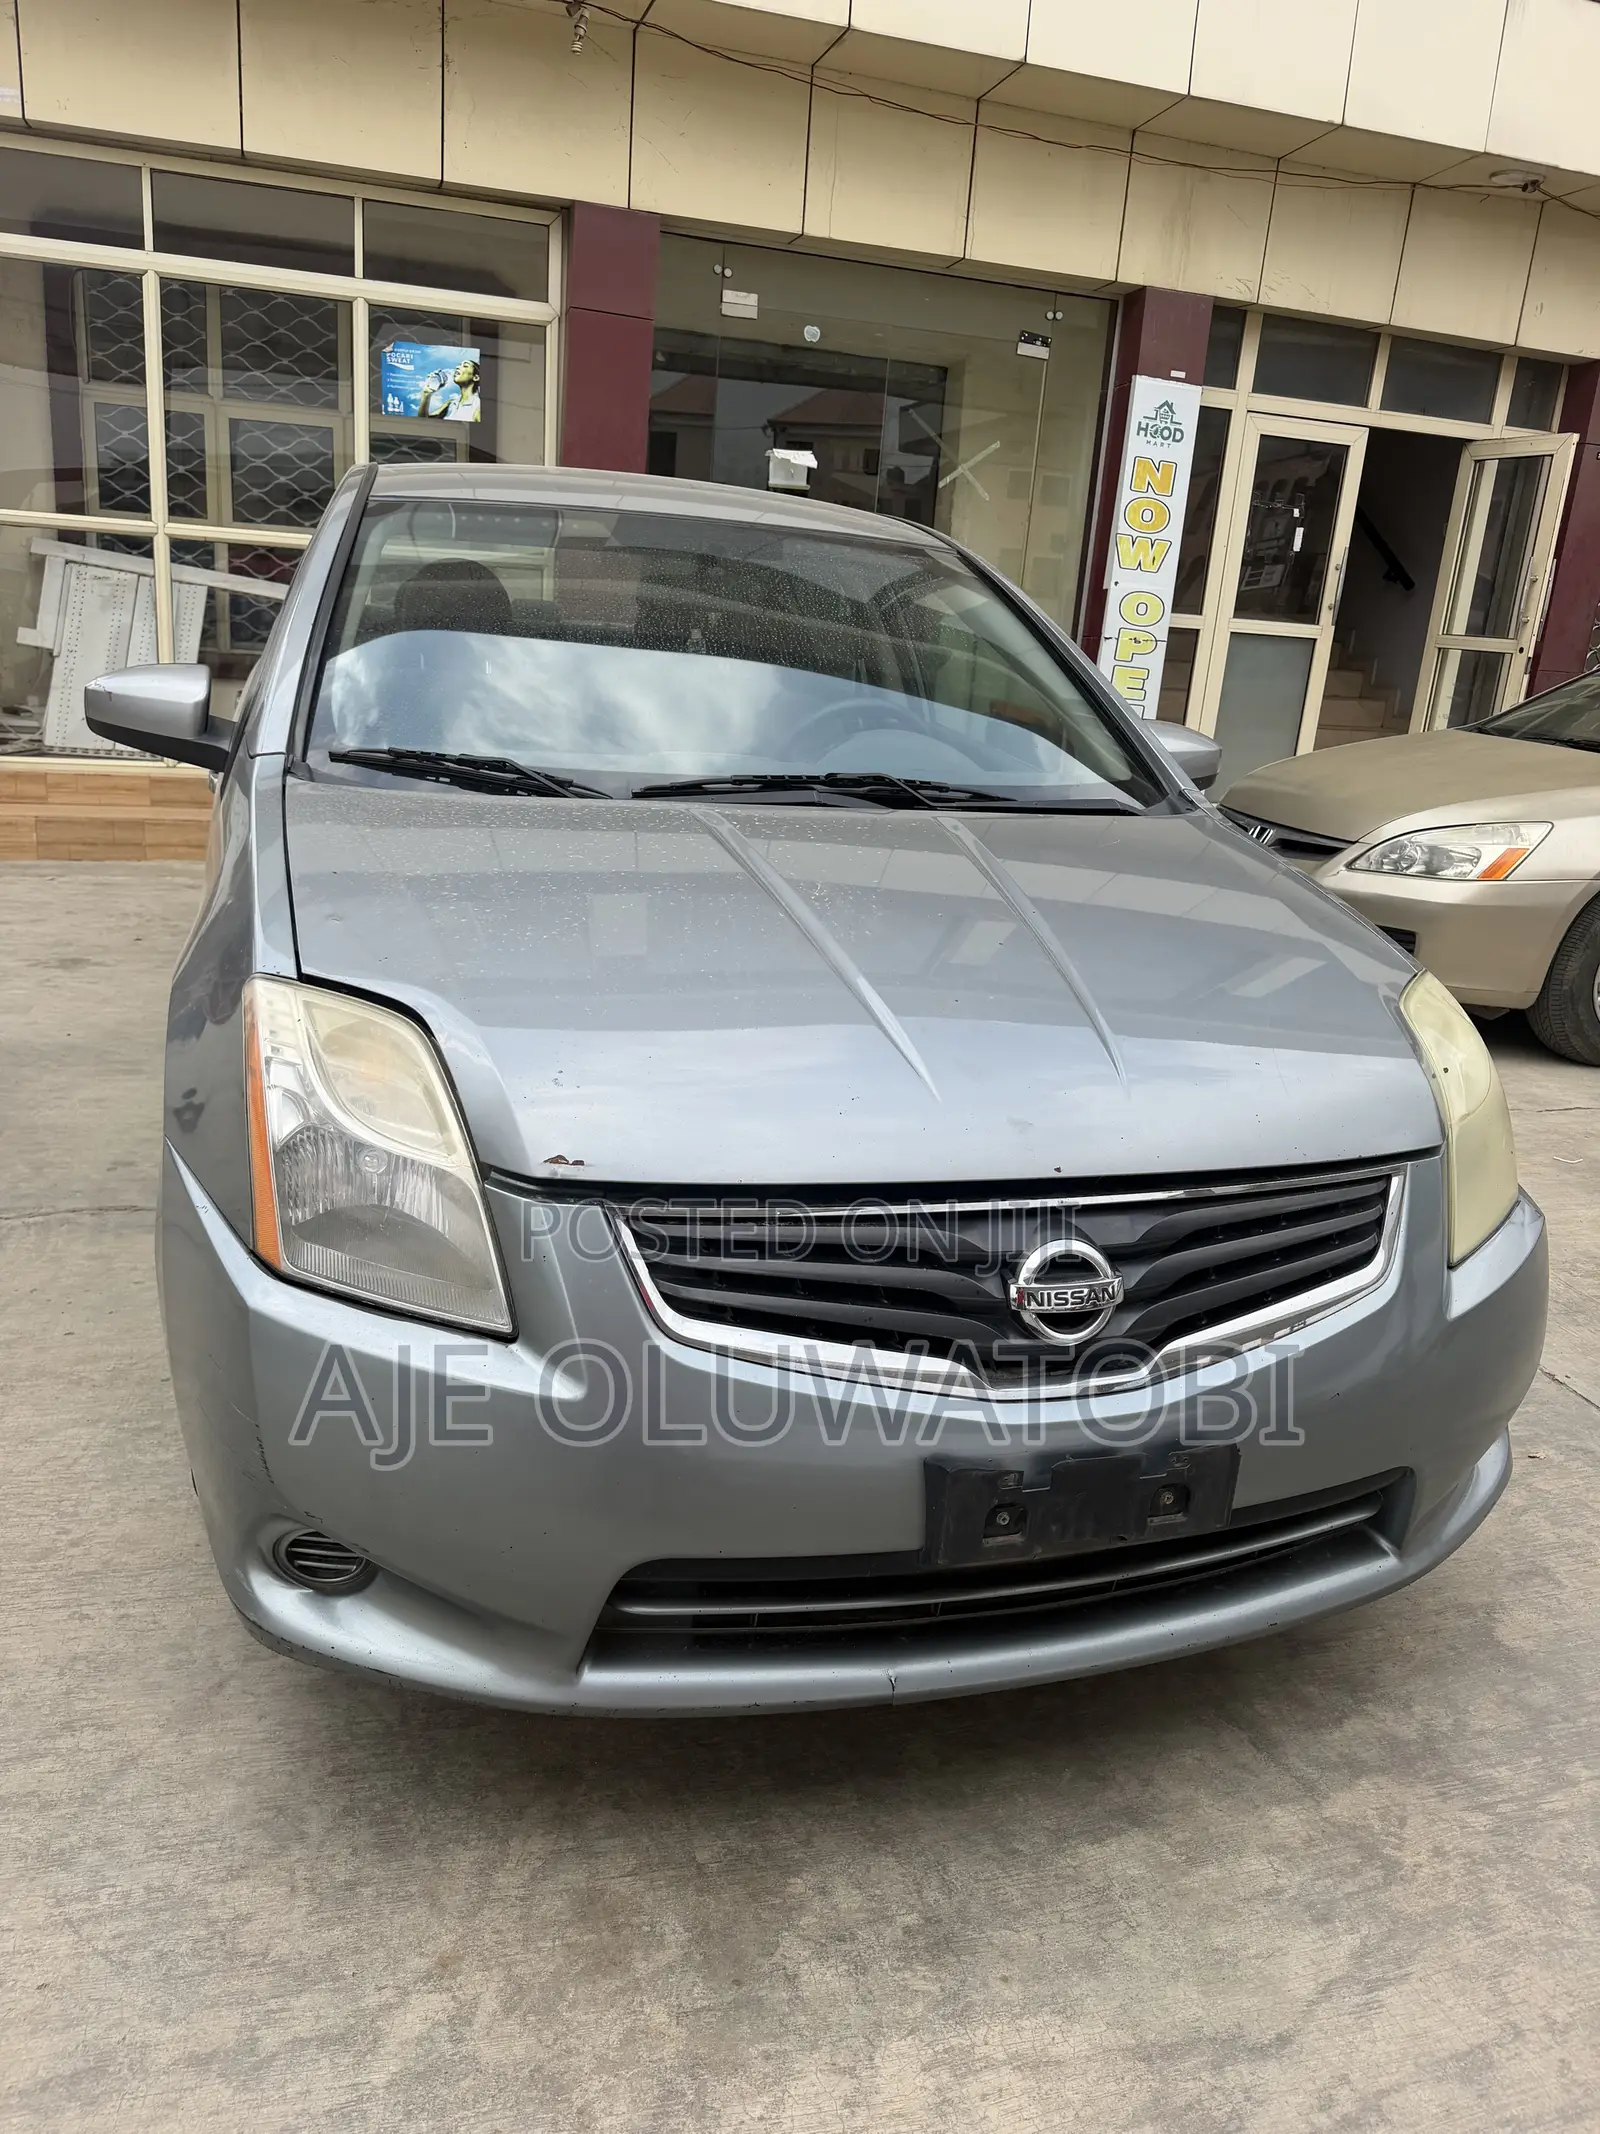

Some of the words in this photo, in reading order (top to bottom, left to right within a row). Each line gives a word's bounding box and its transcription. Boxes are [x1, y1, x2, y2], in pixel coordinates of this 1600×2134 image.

[1136, 421, 1185, 443] HOOD
[1146, 440, 1171, 448] MART
[1115, 456, 1177, 573] NOW
[1109, 591, 1165, 720] OPE
[1026, 1284, 1116, 1307] NISSAN
